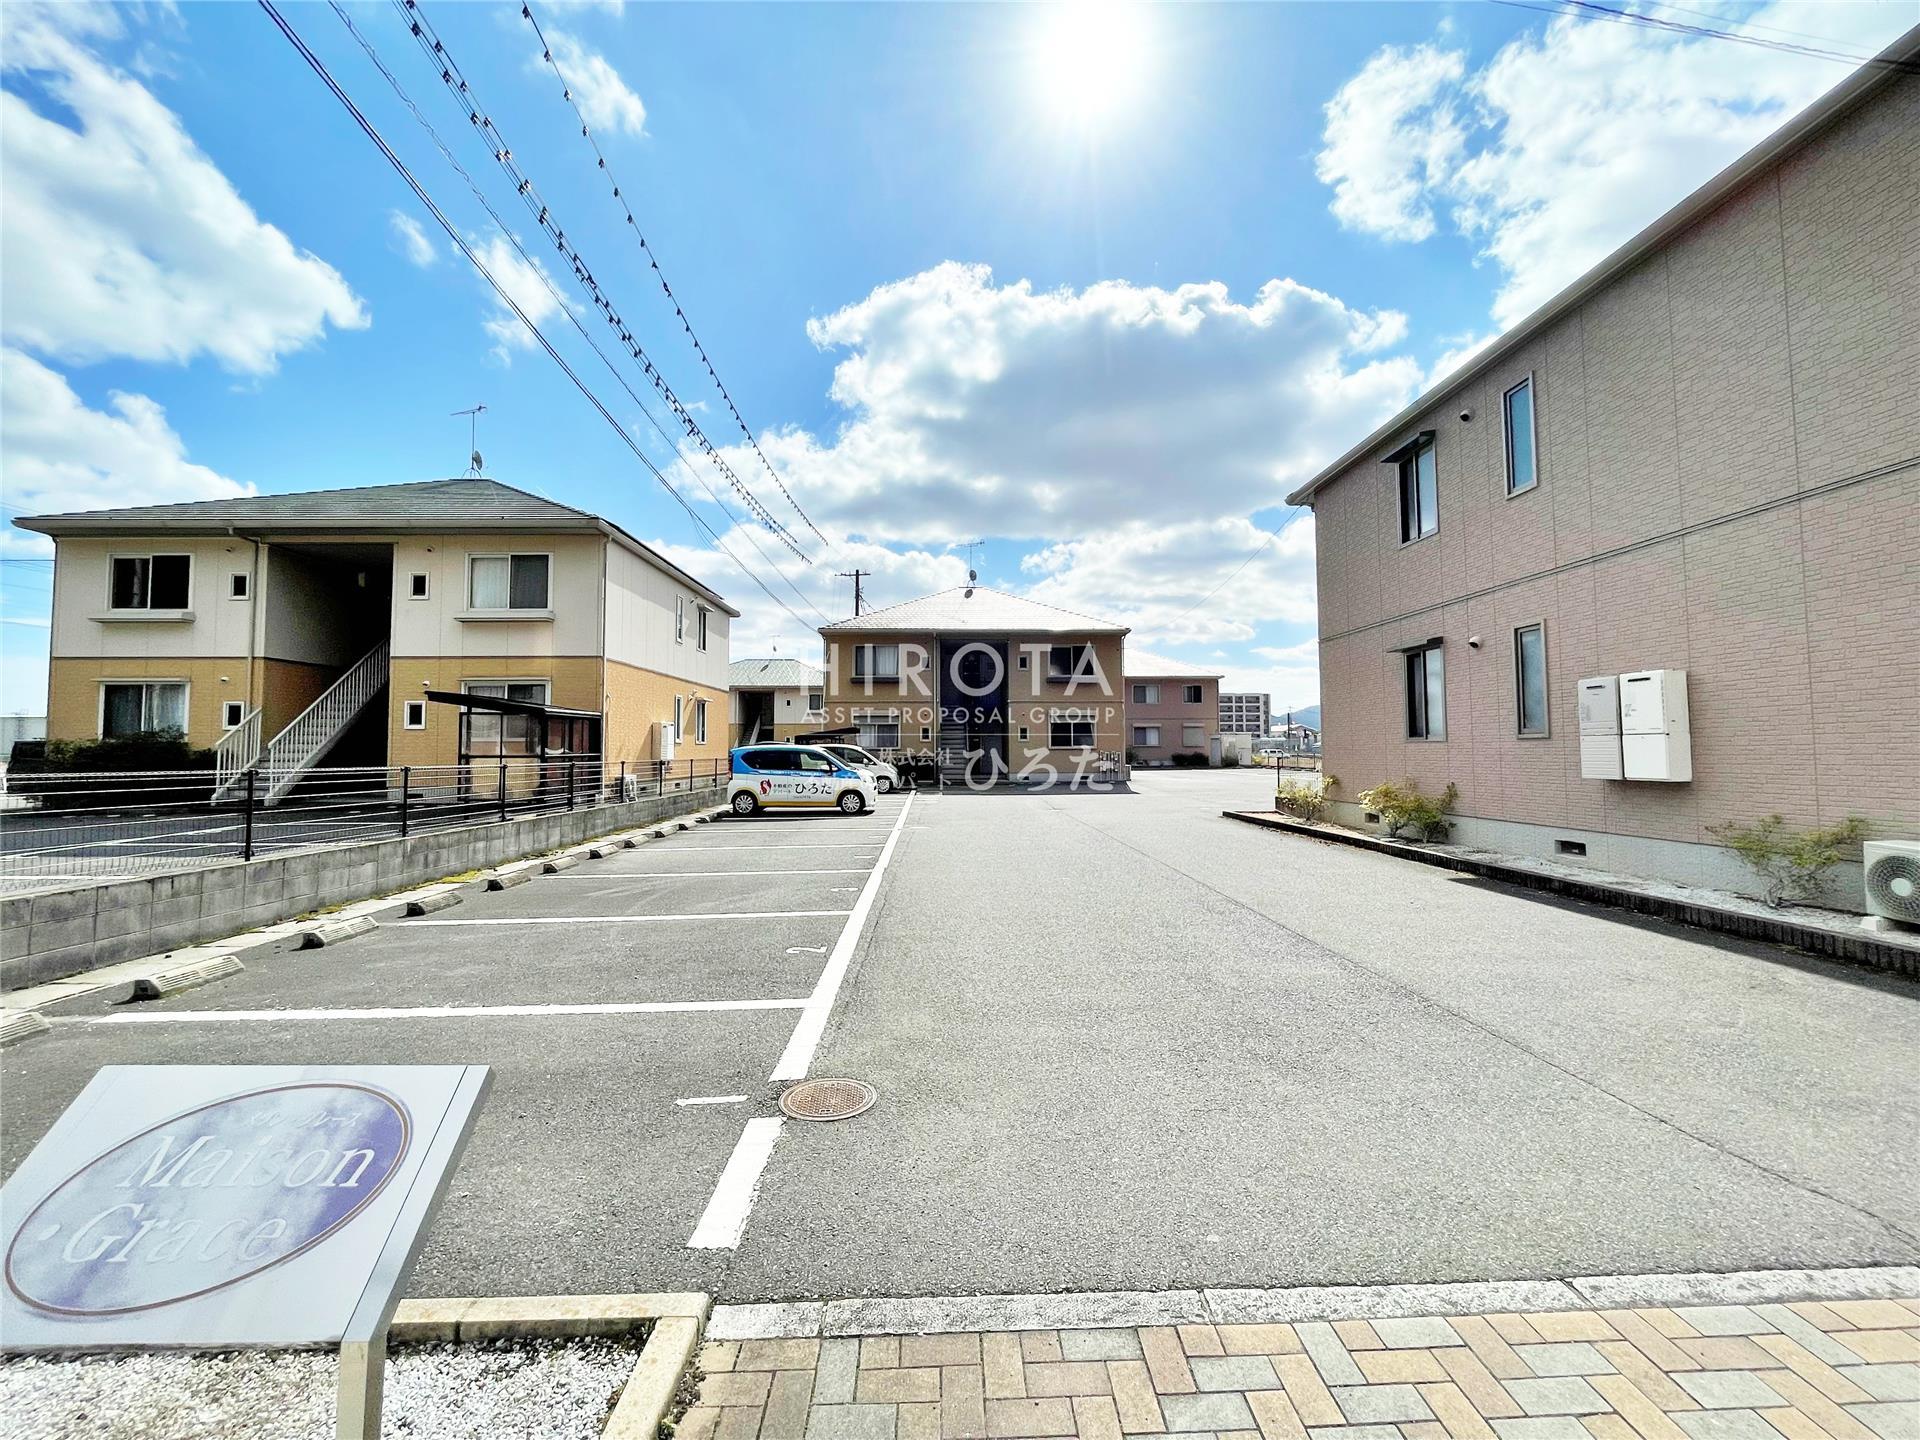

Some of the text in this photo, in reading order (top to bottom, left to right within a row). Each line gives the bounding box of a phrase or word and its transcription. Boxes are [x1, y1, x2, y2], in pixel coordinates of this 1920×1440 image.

[794, 783, 832, 794] ひろた
[114, 1134, 376, 1189] Maison
[62, 1202, 287, 1264] Grace
